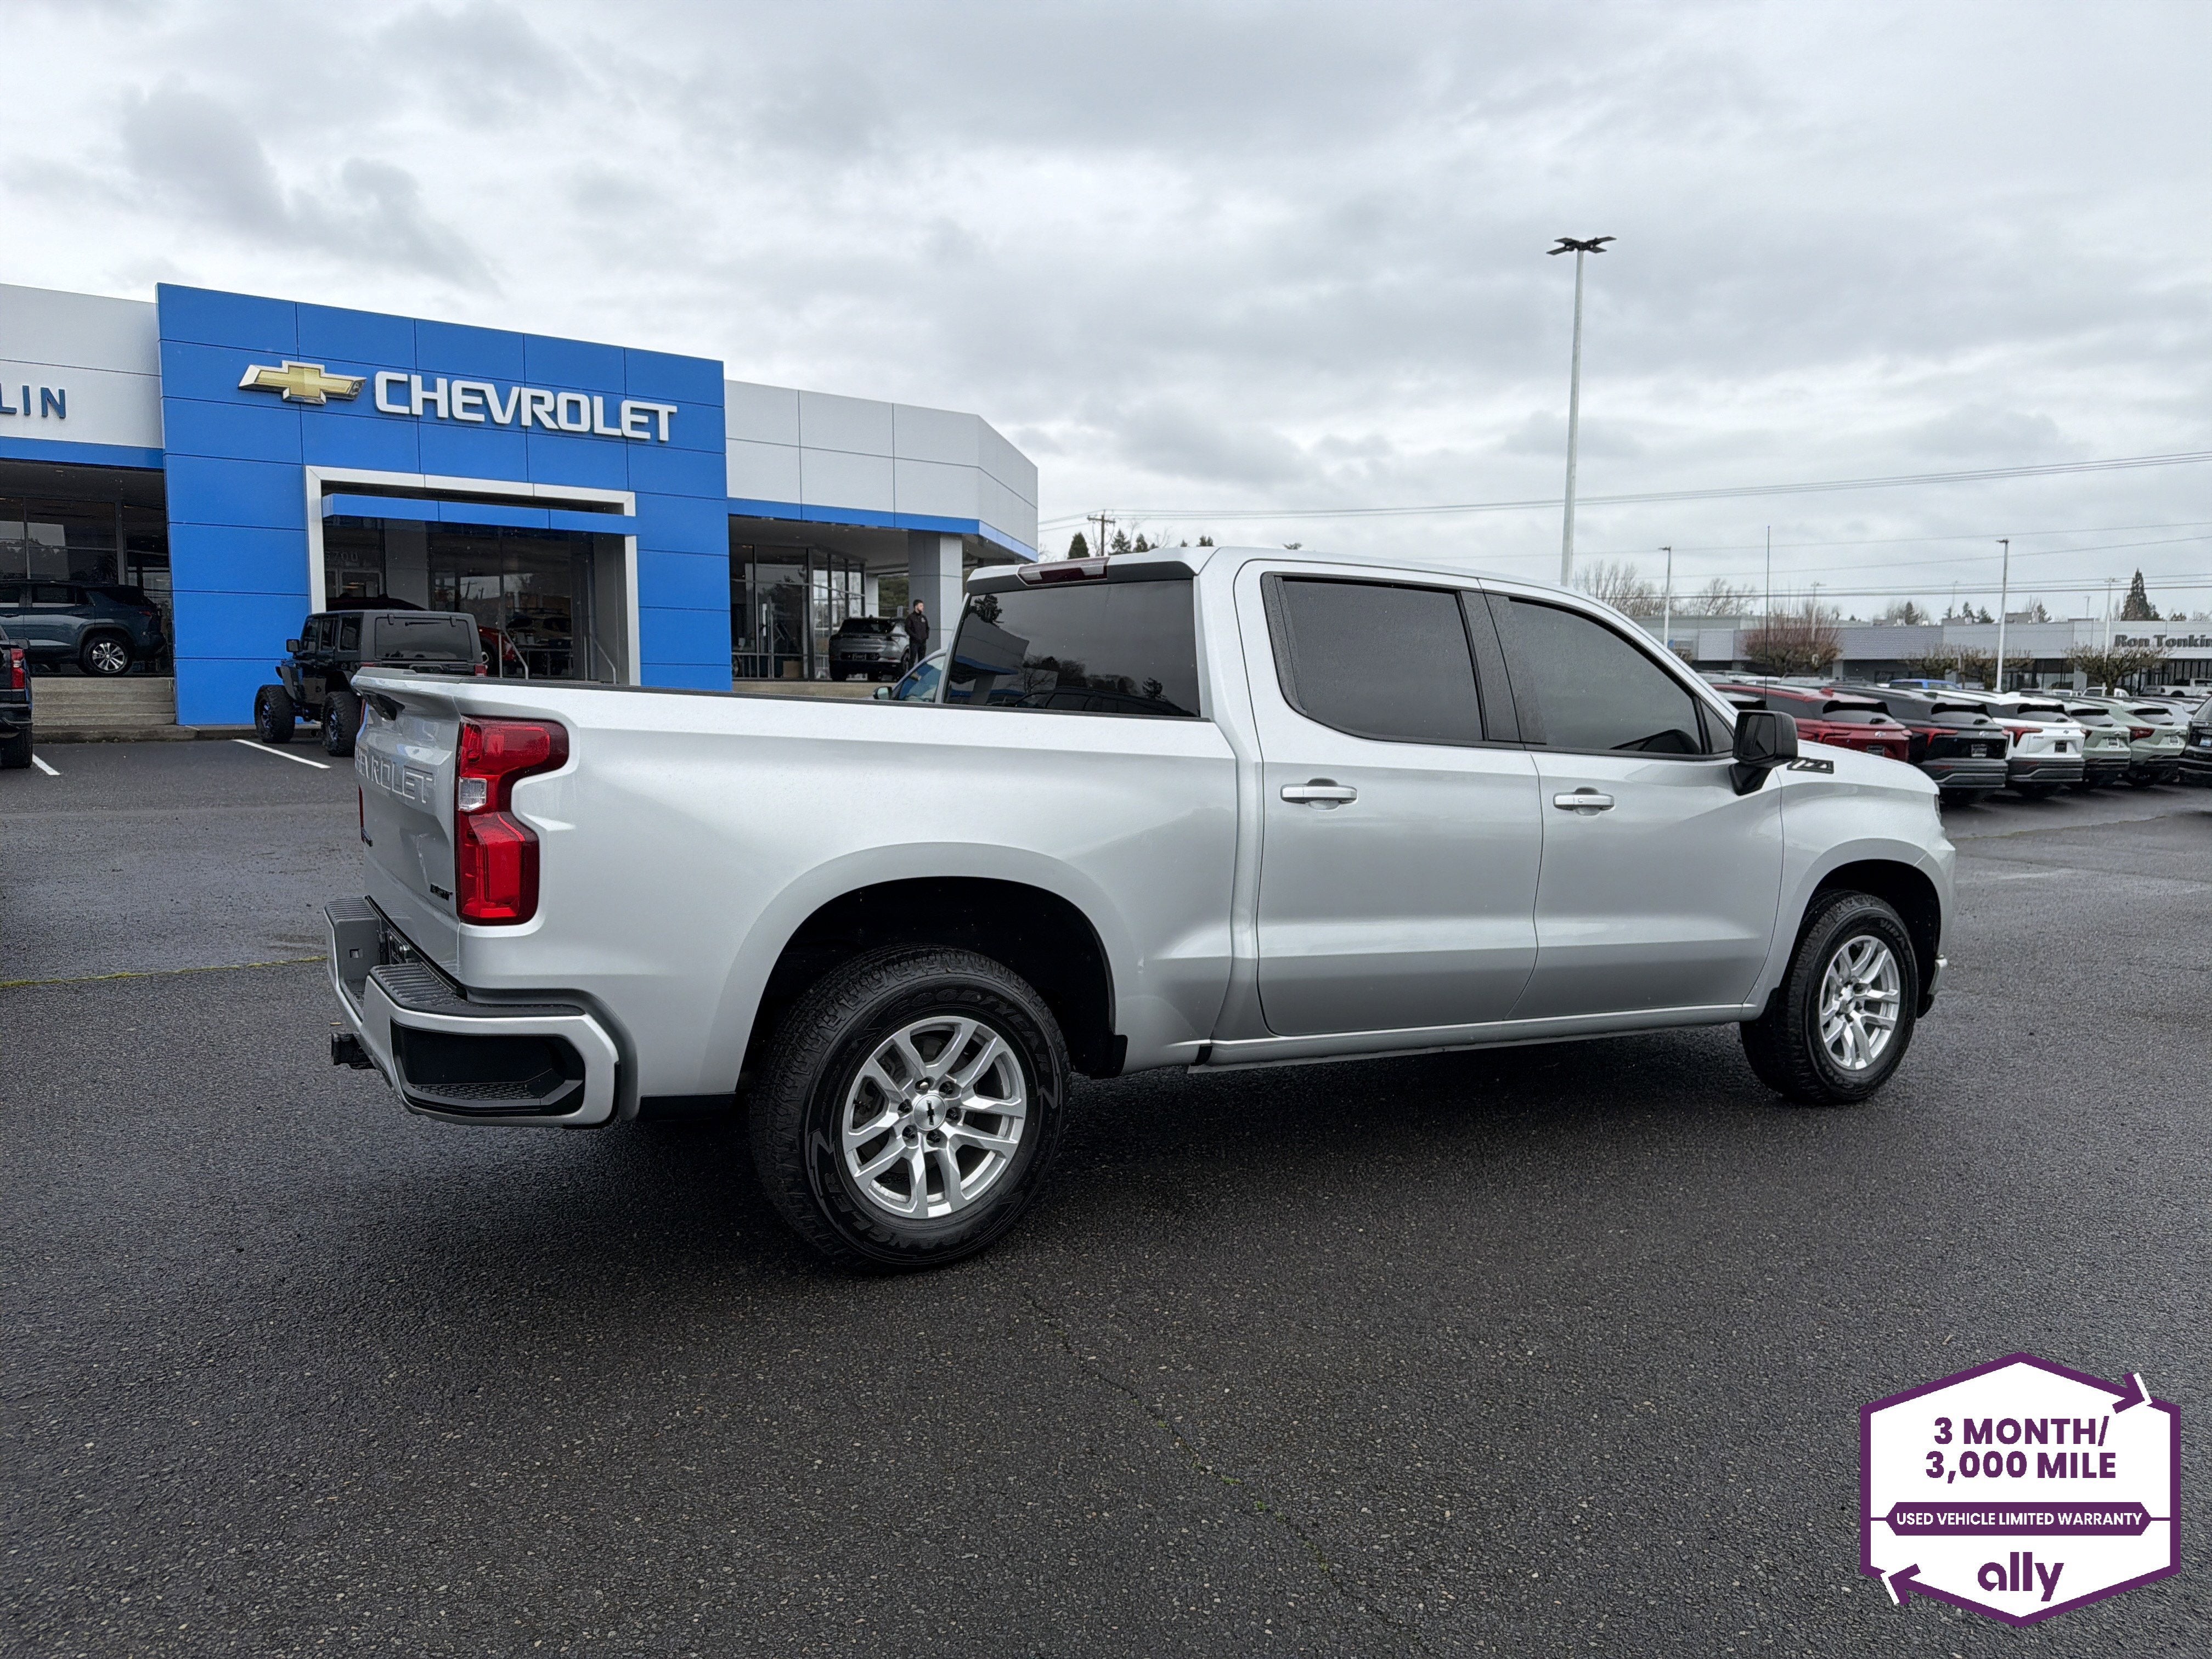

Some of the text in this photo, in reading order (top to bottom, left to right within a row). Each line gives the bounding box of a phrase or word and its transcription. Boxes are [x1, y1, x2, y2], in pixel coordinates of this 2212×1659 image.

[0, 382, 66, 419] LIN
[375, 370, 678, 441] CHEVROLET
[2115, 634, 2150, 647] Ron
